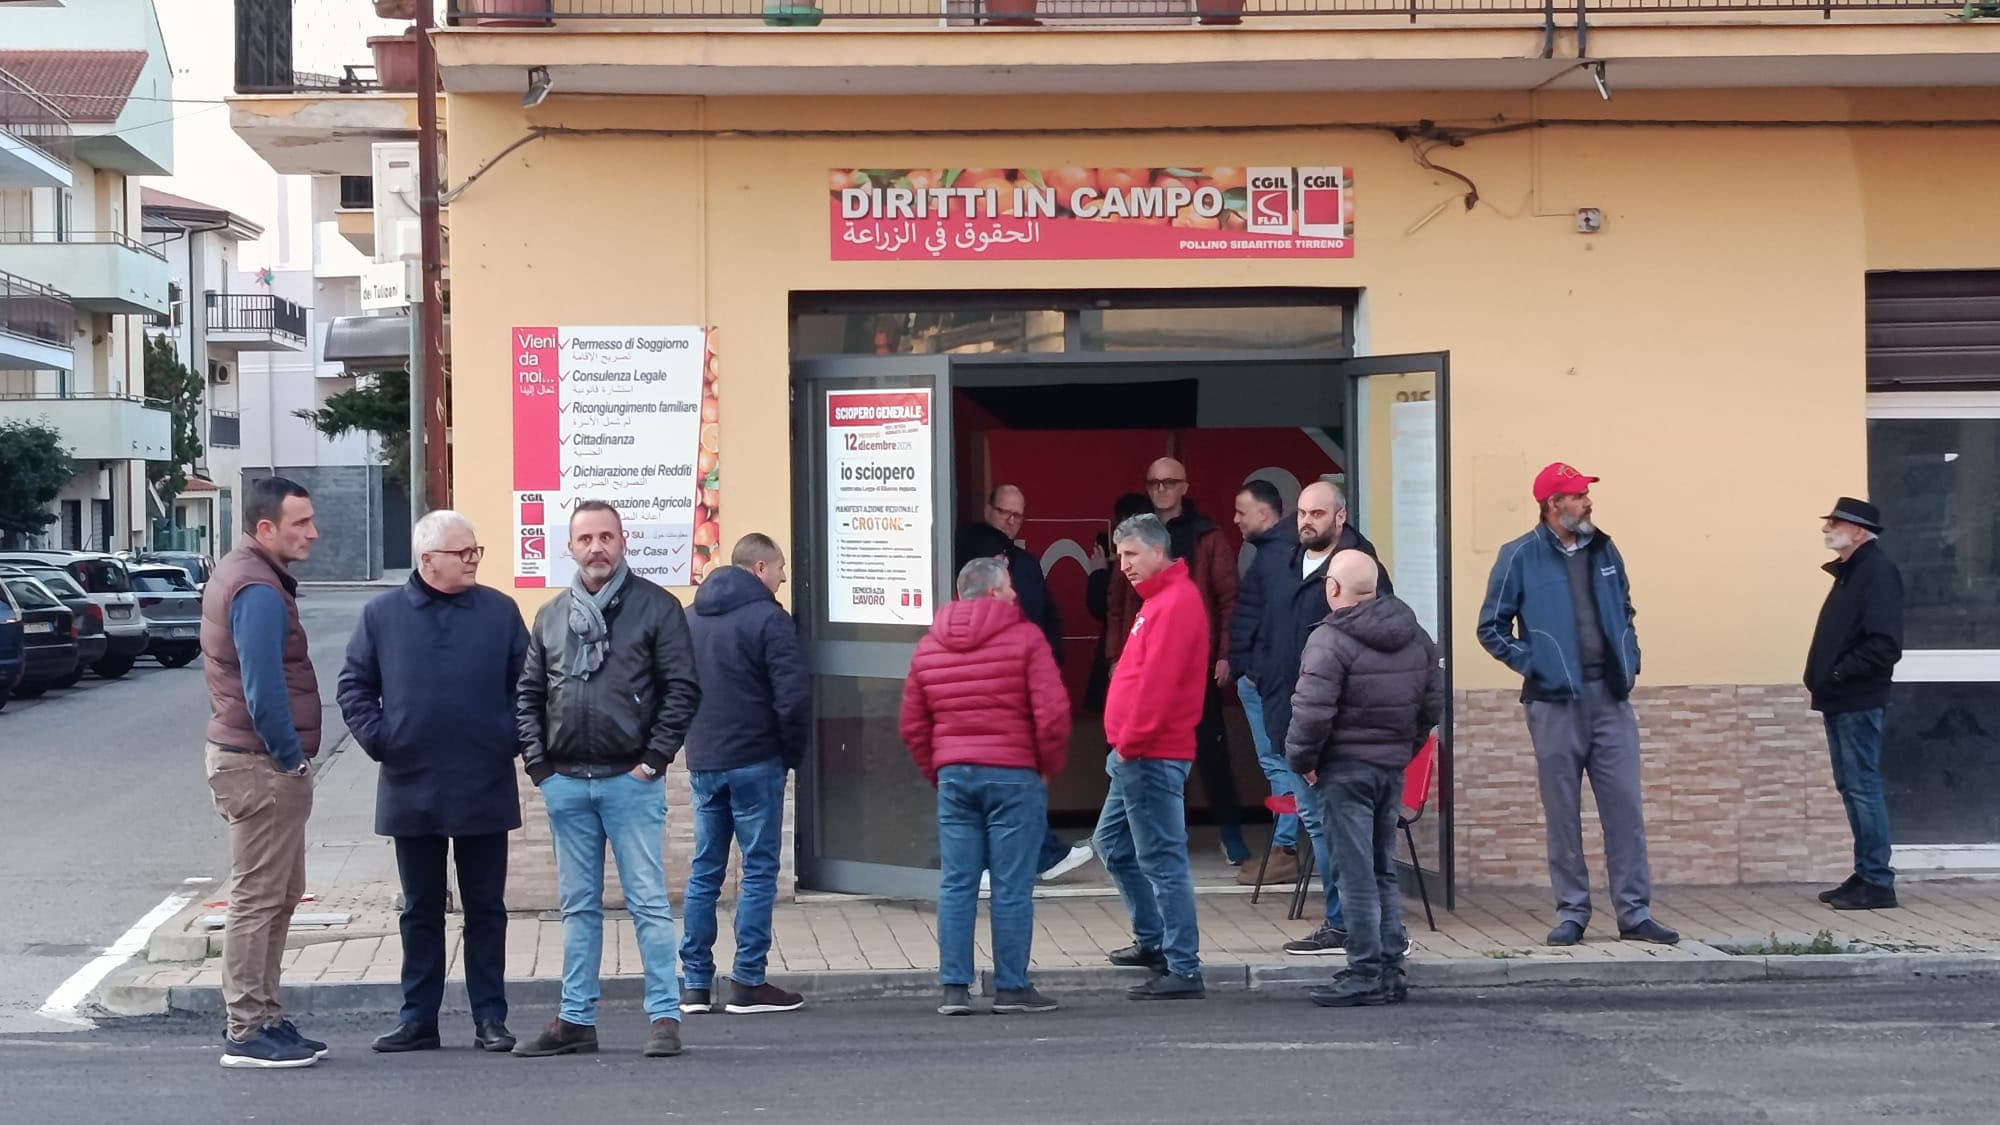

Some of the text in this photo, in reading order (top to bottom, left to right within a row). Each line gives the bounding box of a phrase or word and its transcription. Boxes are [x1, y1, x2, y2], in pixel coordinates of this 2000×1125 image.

[1251, 176, 1288, 189] CGIL
[1303, 175, 1339, 189] CGIL
[842, 186, 1224, 219] DIRITTI IN CAMPO
[1257, 215, 1284, 225] FLAI
[843, 220, 1040, 257] الحقوق في الزراعة
[1179, 239, 1344, 250] POLLINO SIBARITIDE TIRRENO
[518, 333, 556, 349] Vieni
[571, 336, 689, 352] Permesso di Soggiorno
[518, 352, 539, 366] da
[519, 368, 555, 384] noi...
[572, 369, 667, 384] Consulenza Legale
[572, 400, 698, 416] Ricongiungimento familiare
[835, 405, 922, 420] SCIOPERO GENERALE
[573, 433, 635, 446] Cittadinanza
[844, 433, 858, 451] 12
[858, 440, 897, 451] dicembre
[573, 464, 693, 478] Dichiarazione dei Redditi
[841, 461, 915, 485] io sciopero
[520, 493, 544, 502] CGIL
[651, 496, 692, 511] Agricola
[835, 505, 919, 513] MANIFESTAZIONE REGIONALE
[851, 516, 904, 531] CROTONE
[520, 527, 545, 536] CGIL
[643, 546, 668, 556] Casa
